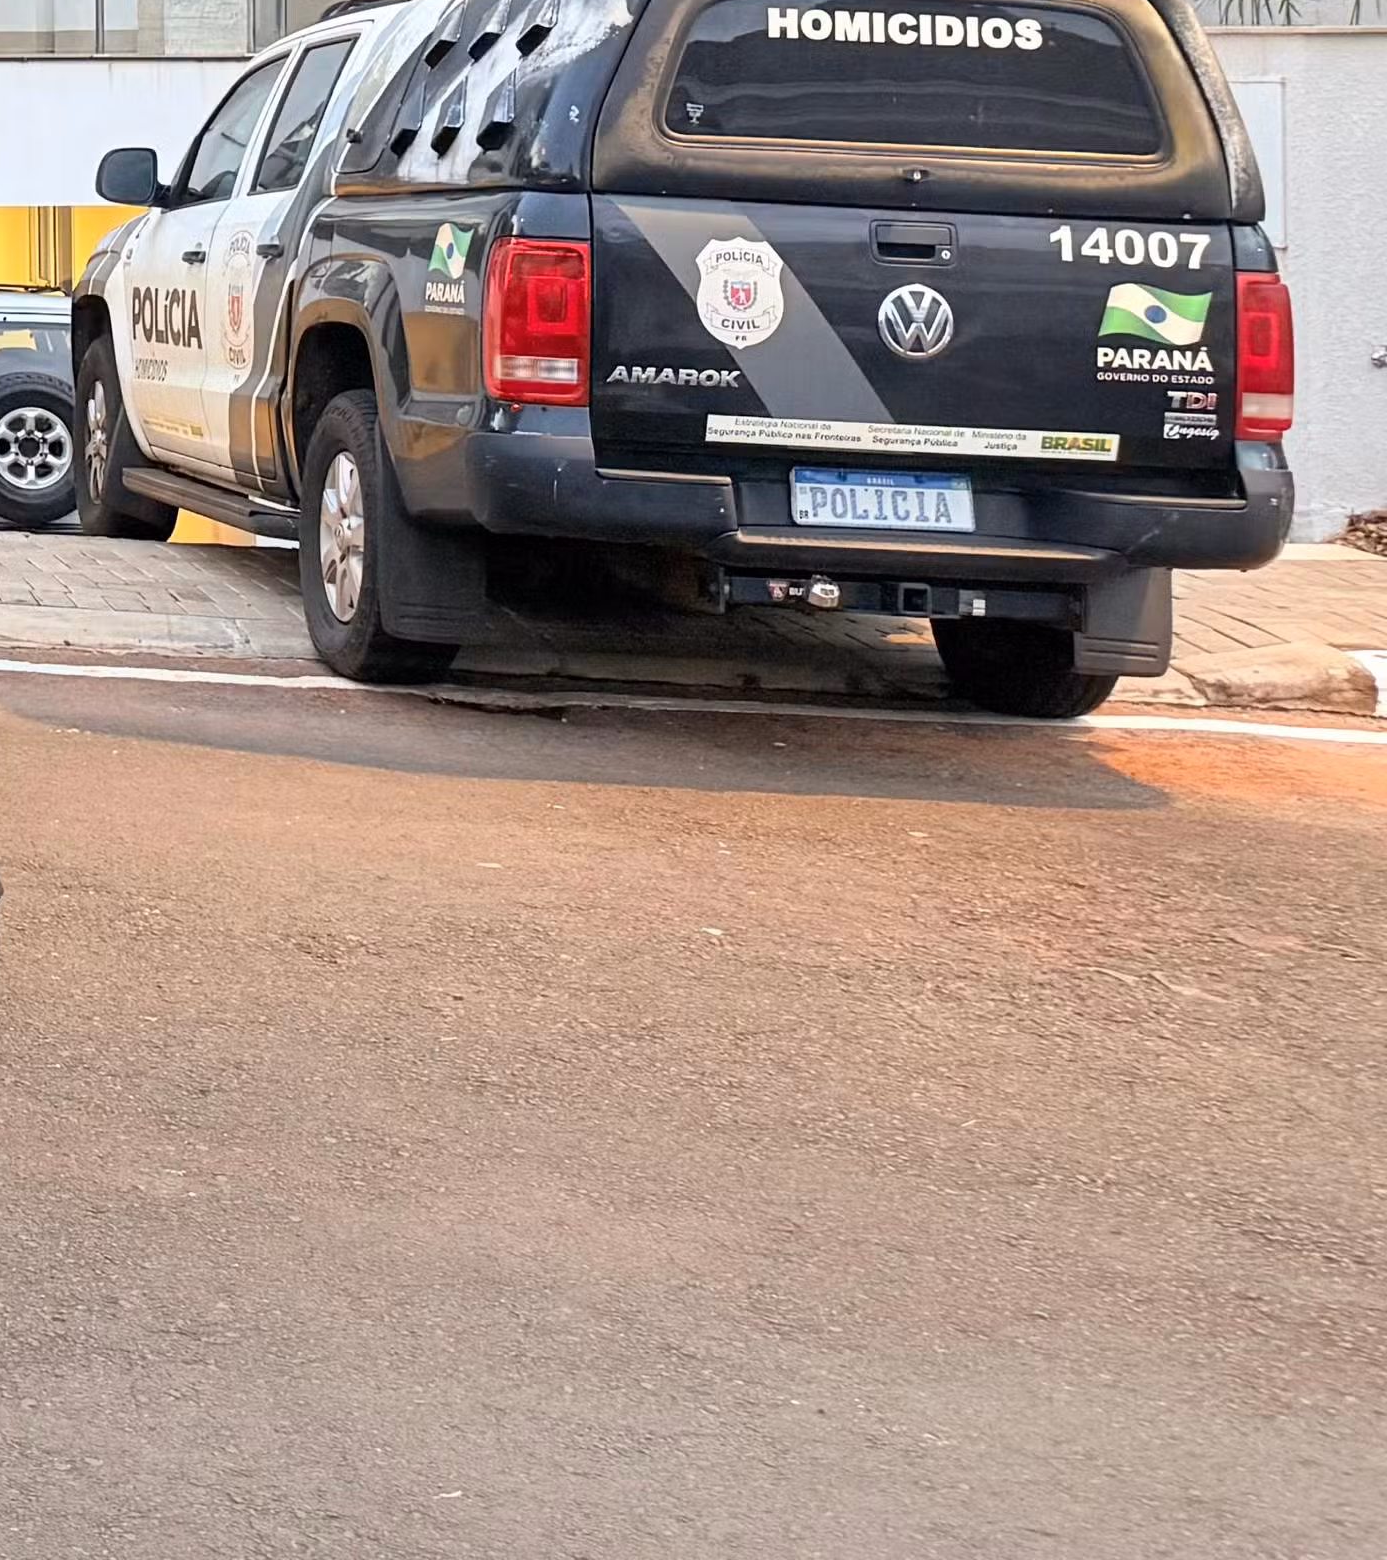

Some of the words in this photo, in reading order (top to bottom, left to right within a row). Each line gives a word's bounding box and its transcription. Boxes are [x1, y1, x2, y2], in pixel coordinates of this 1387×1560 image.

[767, 7, 1043, 51] HOMICIDIOS
[1049, 225, 1212, 270] 14007
[425, 280, 465, 304] PARANÁ
[132, 286, 203, 350] POLÍCIA
[721, 318, 760, 330] CIVIL
[1097, 346, 1214, 372] PARANÁ
[606, 365, 741, 388] AMAROK
[1096, 371, 1149, 383] GOVERNO
[1152, 374, 1168, 383] DO
[1171, 375, 1215, 385] ESTADO
[1167, 390, 1218, 410] TDI
[707, 426, 757, 438] Segurança
[814, 431, 862, 443] Fronteiras
[872, 435, 922, 447] Segurança
[1040, 436, 1112, 453] BRASIL
[984, 440, 1018, 452] Justiça
